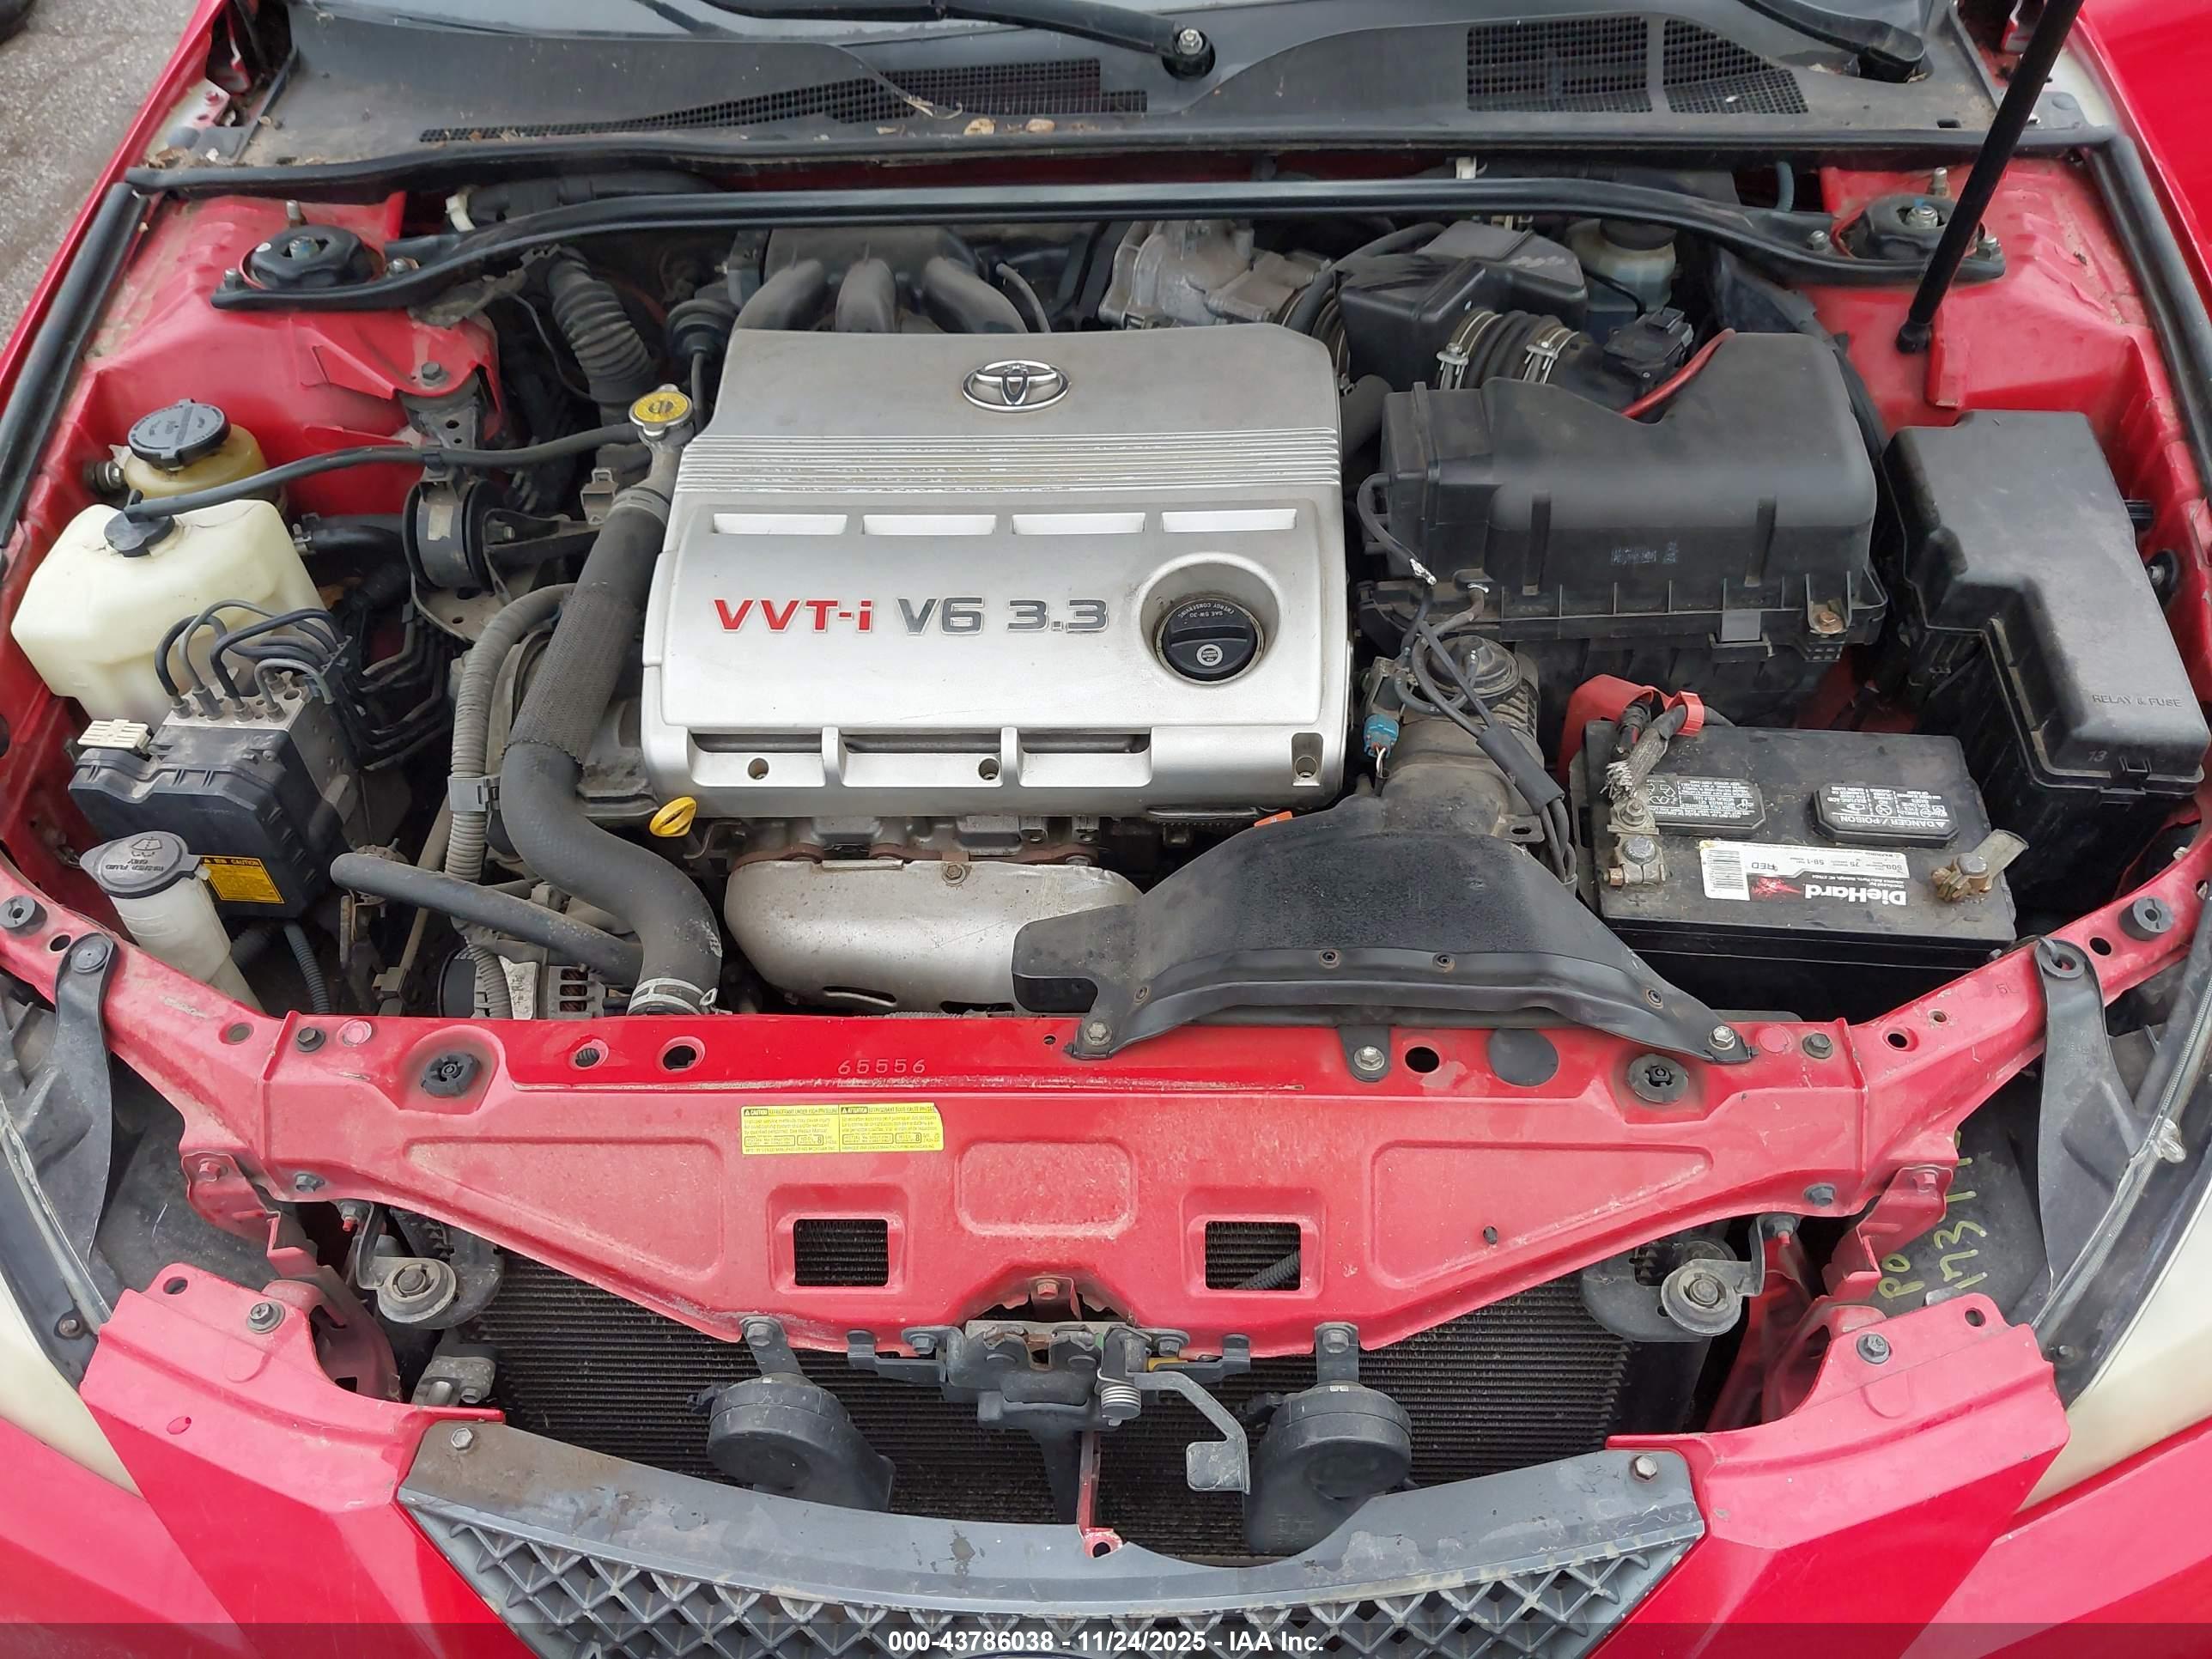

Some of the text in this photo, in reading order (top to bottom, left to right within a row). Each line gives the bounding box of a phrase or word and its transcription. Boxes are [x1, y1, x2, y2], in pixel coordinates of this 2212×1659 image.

[713, 598, 1110, 635] VVT-i V6 3.3
[2092, 694, 2131, 705] RELAY
[2149, 697, 2183, 708] FUSE
[1840, 815, 1881, 824] POISON
[1891, 818, 1936, 827] DANGER
[1805, 884, 1906, 906] DieHard
[836, 1058, 927, 1075] 65556
